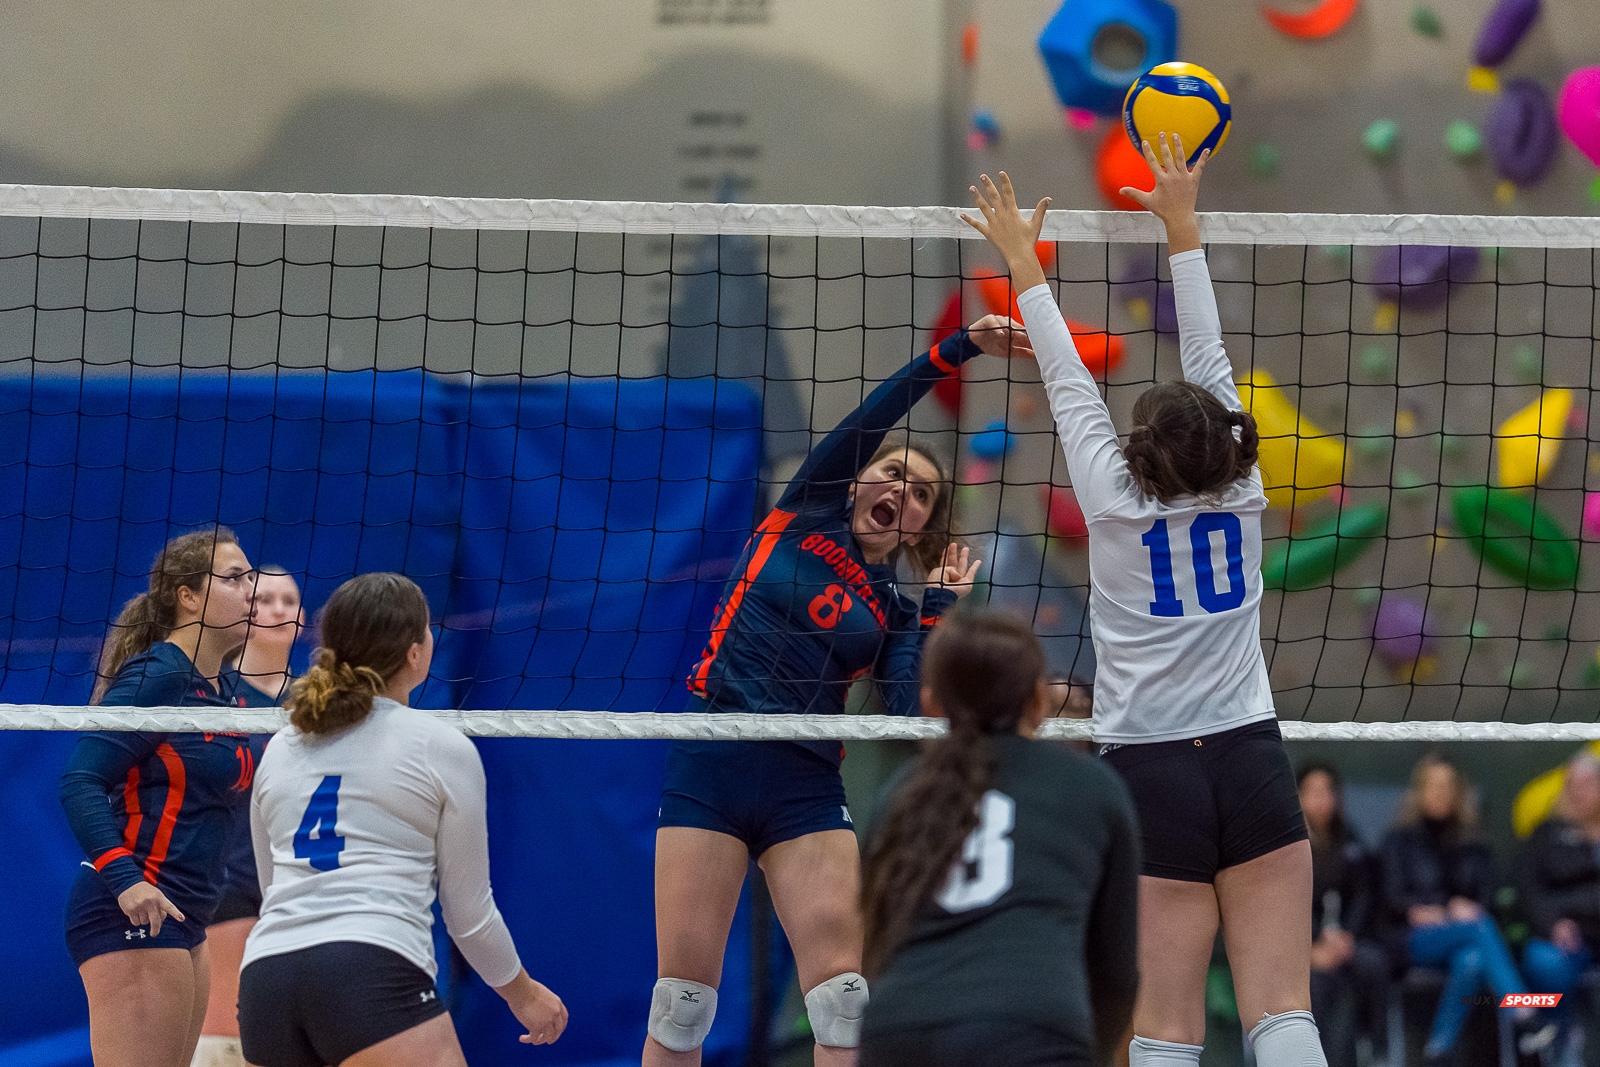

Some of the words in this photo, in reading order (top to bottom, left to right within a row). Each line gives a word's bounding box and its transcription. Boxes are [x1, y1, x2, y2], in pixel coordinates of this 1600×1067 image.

[808, 585, 853, 629] 8
[1141, 512, 1246, 617] 10
[292, 775, 345, 872] 4
